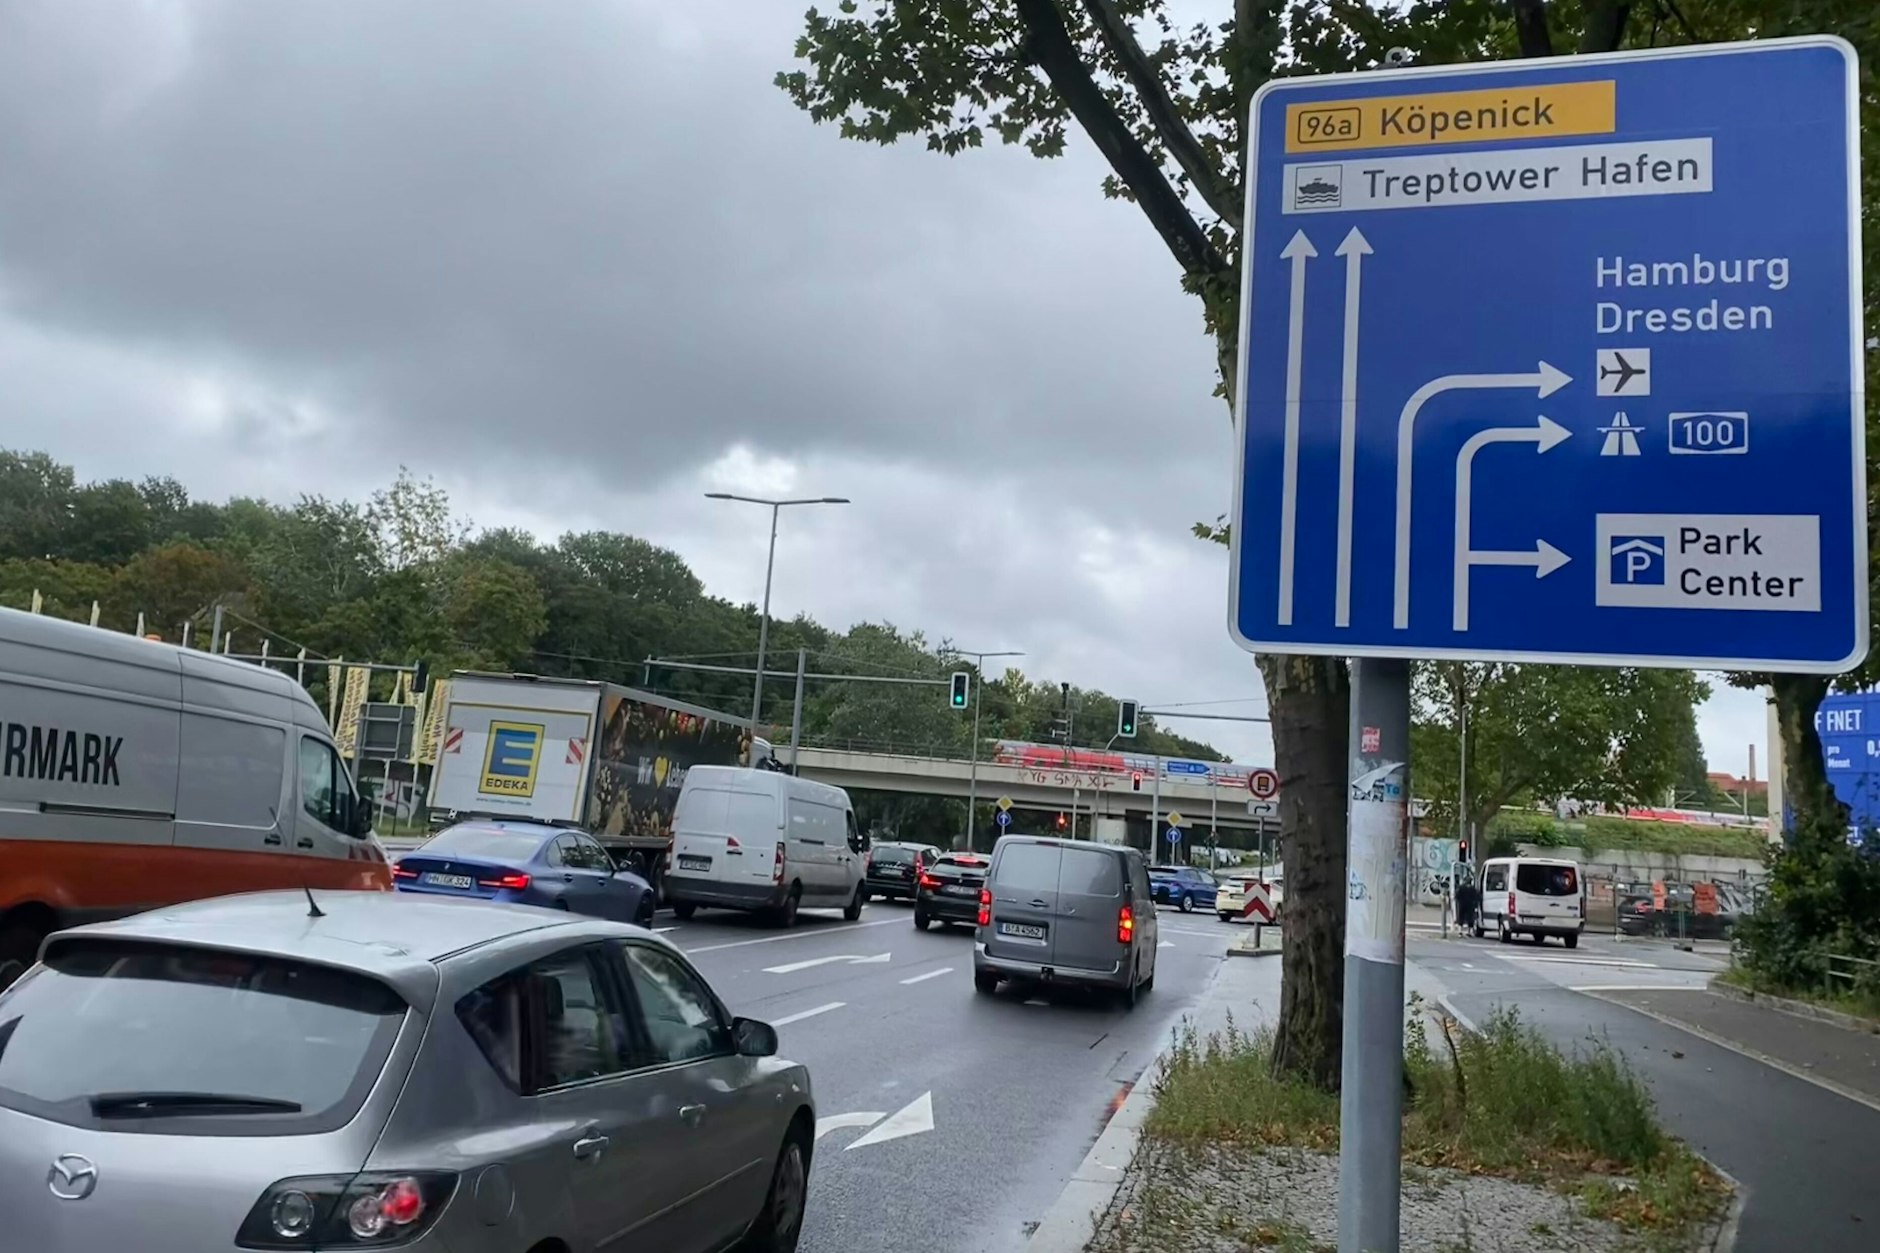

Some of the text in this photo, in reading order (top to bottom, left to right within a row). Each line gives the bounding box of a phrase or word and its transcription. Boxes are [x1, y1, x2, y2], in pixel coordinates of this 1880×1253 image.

[1306, 96, 1555, 140] 96a Köpenick
[1362, 153, 1699, 203] Treptower Hafen
[1596, 253, 1790, 290] Hamburg
[1596, 299, 1773, 334] Dresden
[1683, 420, 1734, 446] 100
[1680, 527, 1763, 555] Park
[1626, 551, 1651, 582] P
[1680, 568, 1804, 597] Center
[0, 721, 124, 787] RMARK
[485, 777, 529, 791] EDEKA
